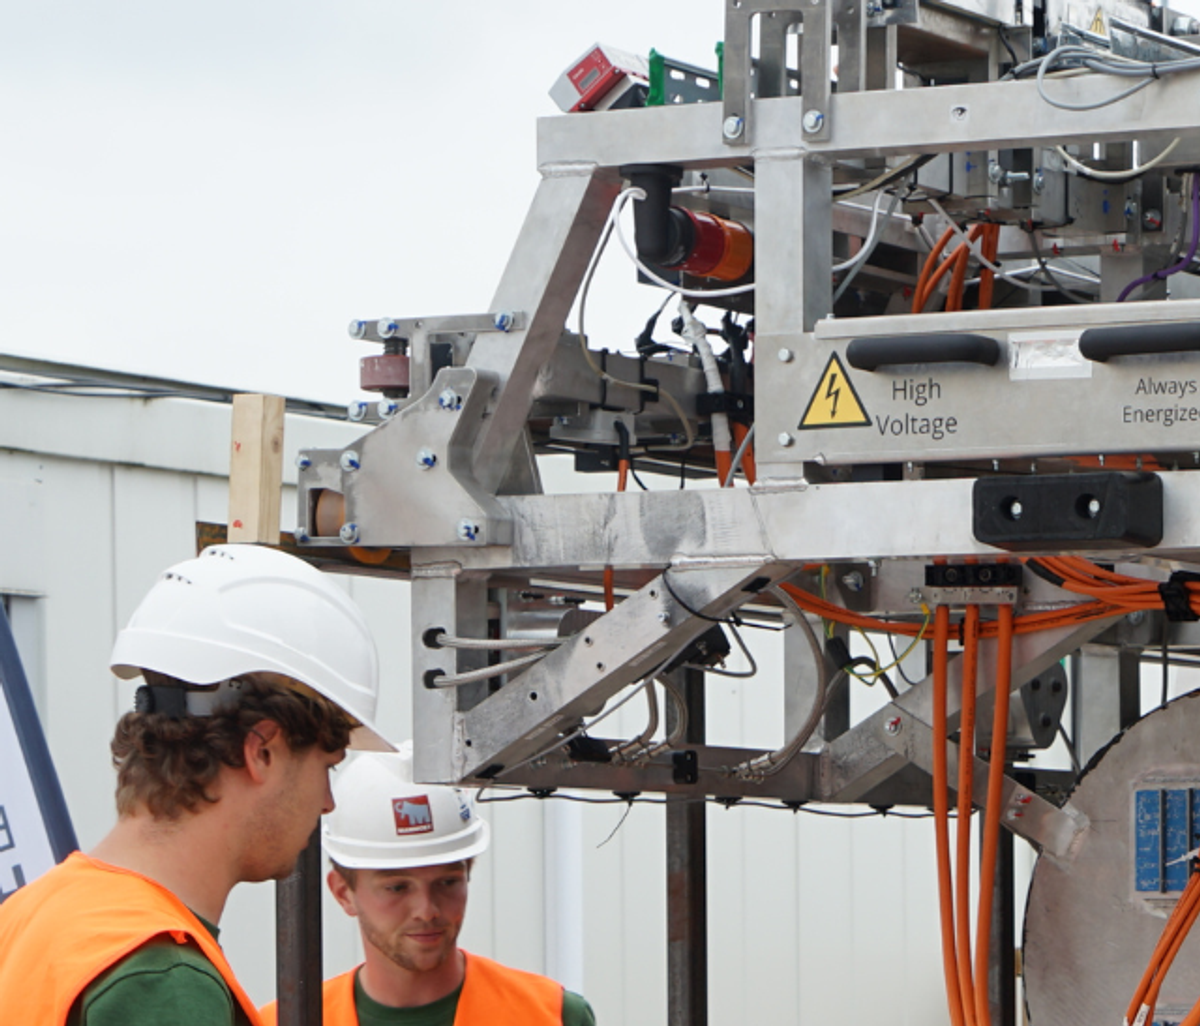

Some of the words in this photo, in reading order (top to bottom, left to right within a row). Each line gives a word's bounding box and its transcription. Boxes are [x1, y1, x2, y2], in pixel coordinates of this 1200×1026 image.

[892, 377, 941, 406] High
[1135, 377, 1198, 398] Always
[876, 412, 958, 440] Voltage
